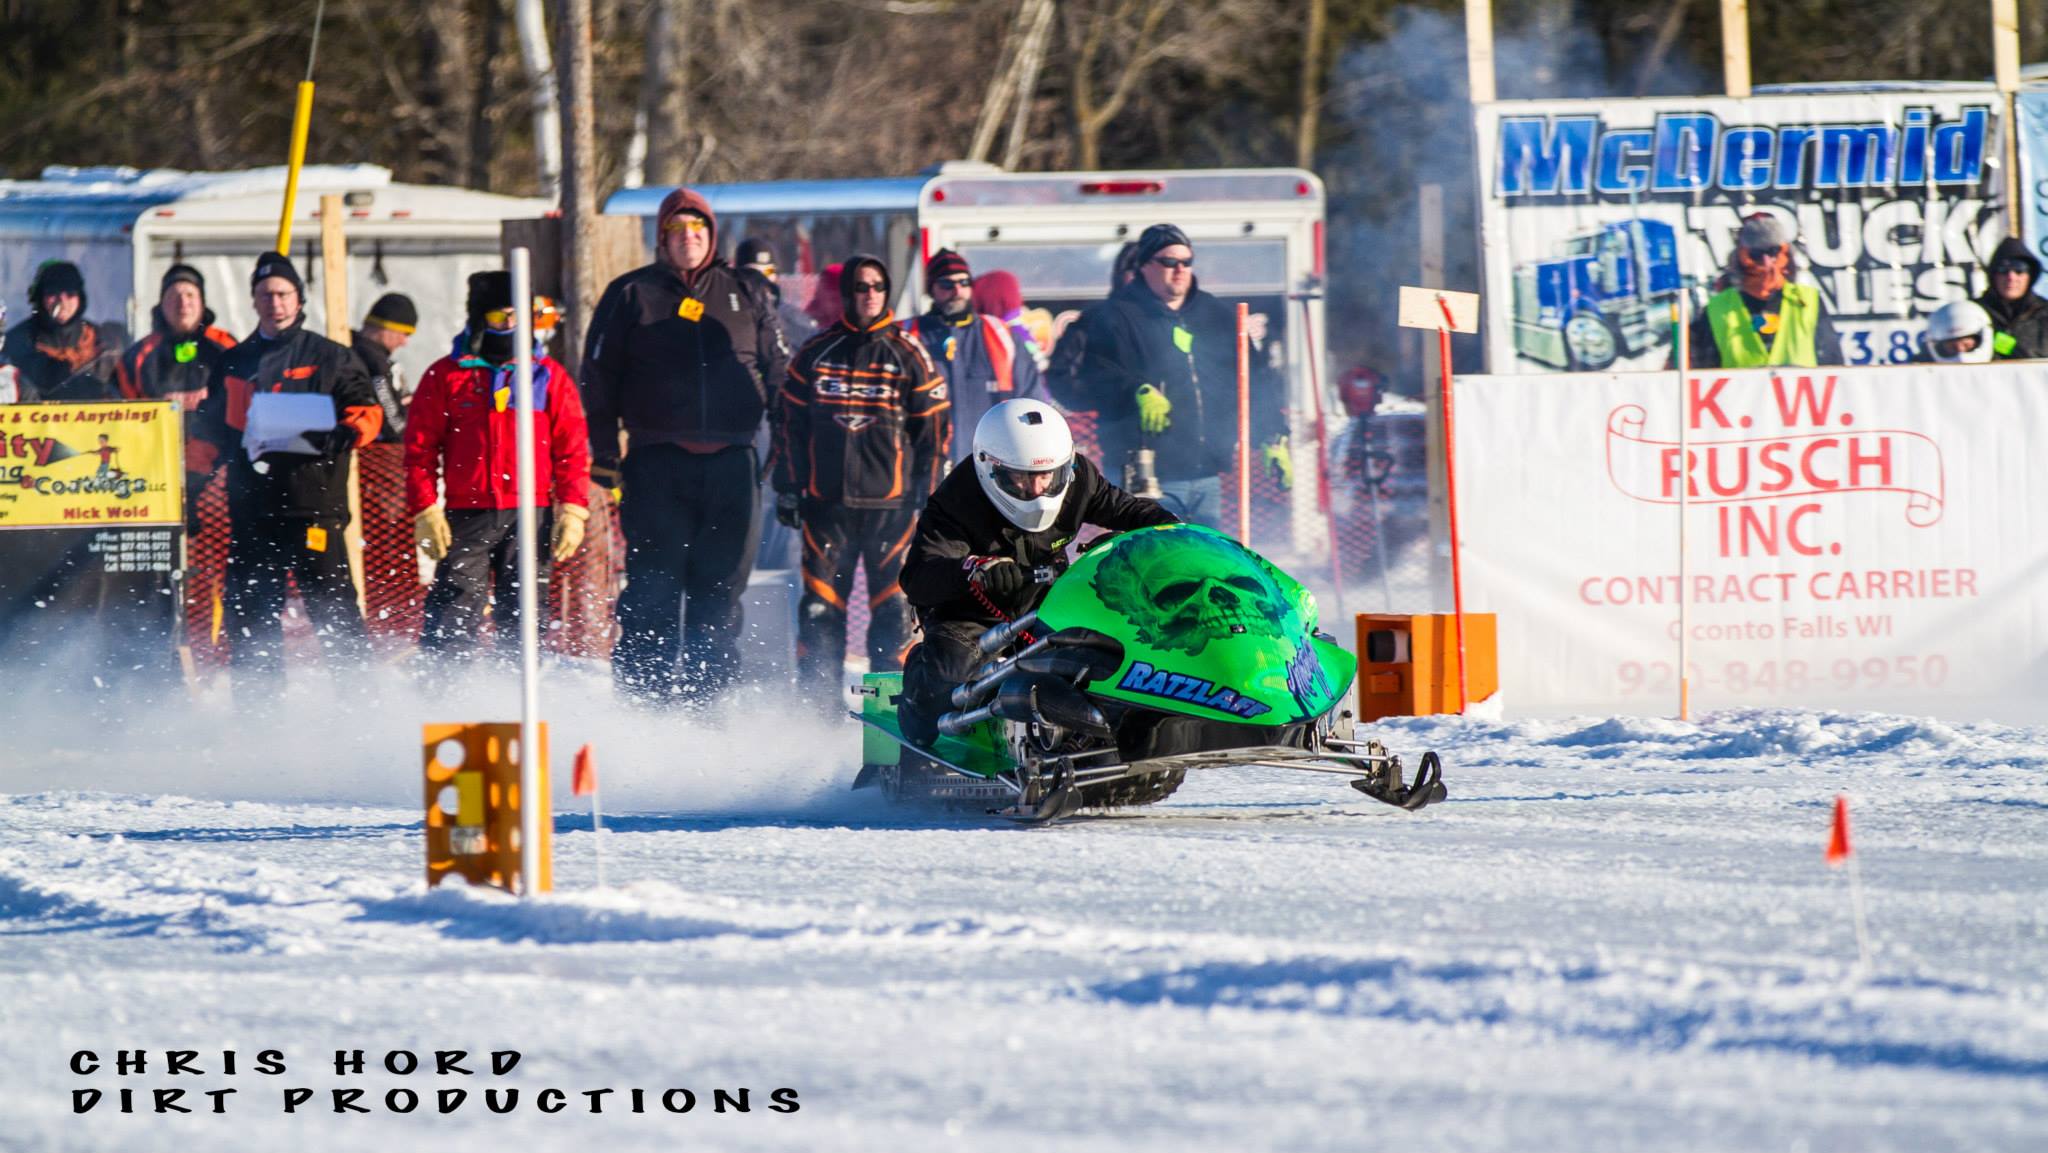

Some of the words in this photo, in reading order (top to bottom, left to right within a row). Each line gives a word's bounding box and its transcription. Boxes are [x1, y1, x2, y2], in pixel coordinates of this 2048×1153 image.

[1499, 105, 1990, 198] McDermid
[75, 408, 158, 425] Anything!
[1689, 377, 1753, 429] K.
[1771, 375, 1854, 427] W.
[1661, 436, 1893, 498] RUSCH
[63, 507, 101, 519] Nick
[1718, 503, 1842, 558] INC.
[1578, 574, 1798, 606] CONTRACT
[1808, 568, 1979, 601] CARRIER
[1783, 616, 1849, 640] Falls
[1855, 615, 1893, 638] WI
[1617, 654, 1950, 696] 920-848-9950
